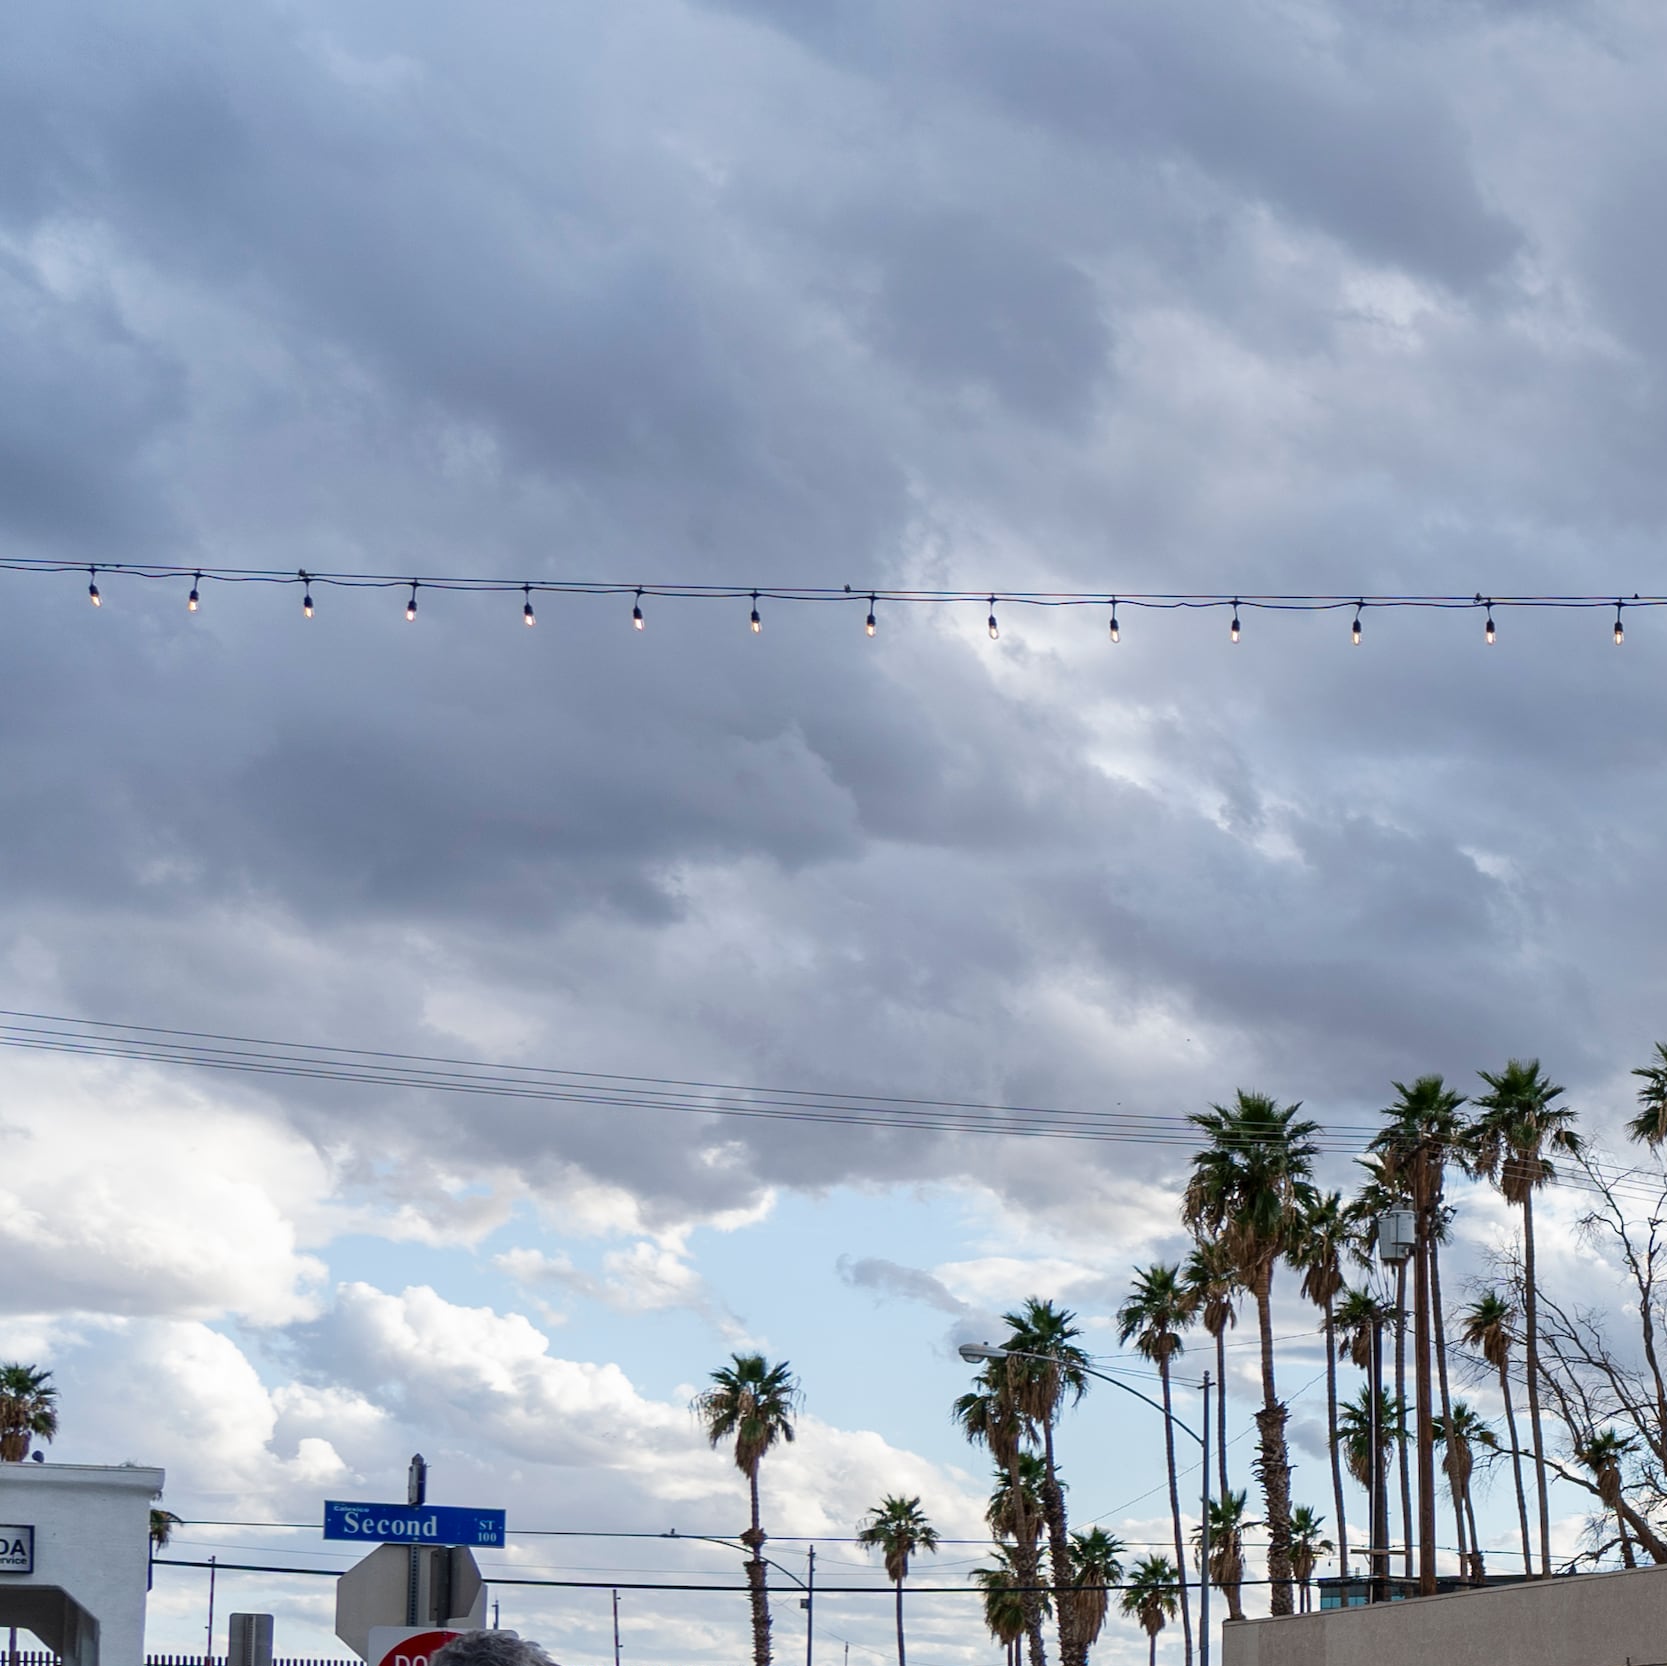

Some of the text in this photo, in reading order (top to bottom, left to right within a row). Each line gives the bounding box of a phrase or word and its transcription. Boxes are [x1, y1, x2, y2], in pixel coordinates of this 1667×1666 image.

[344, 1511, 496, 1537] Second ST
[477, 1532, 497, 1543] 100
